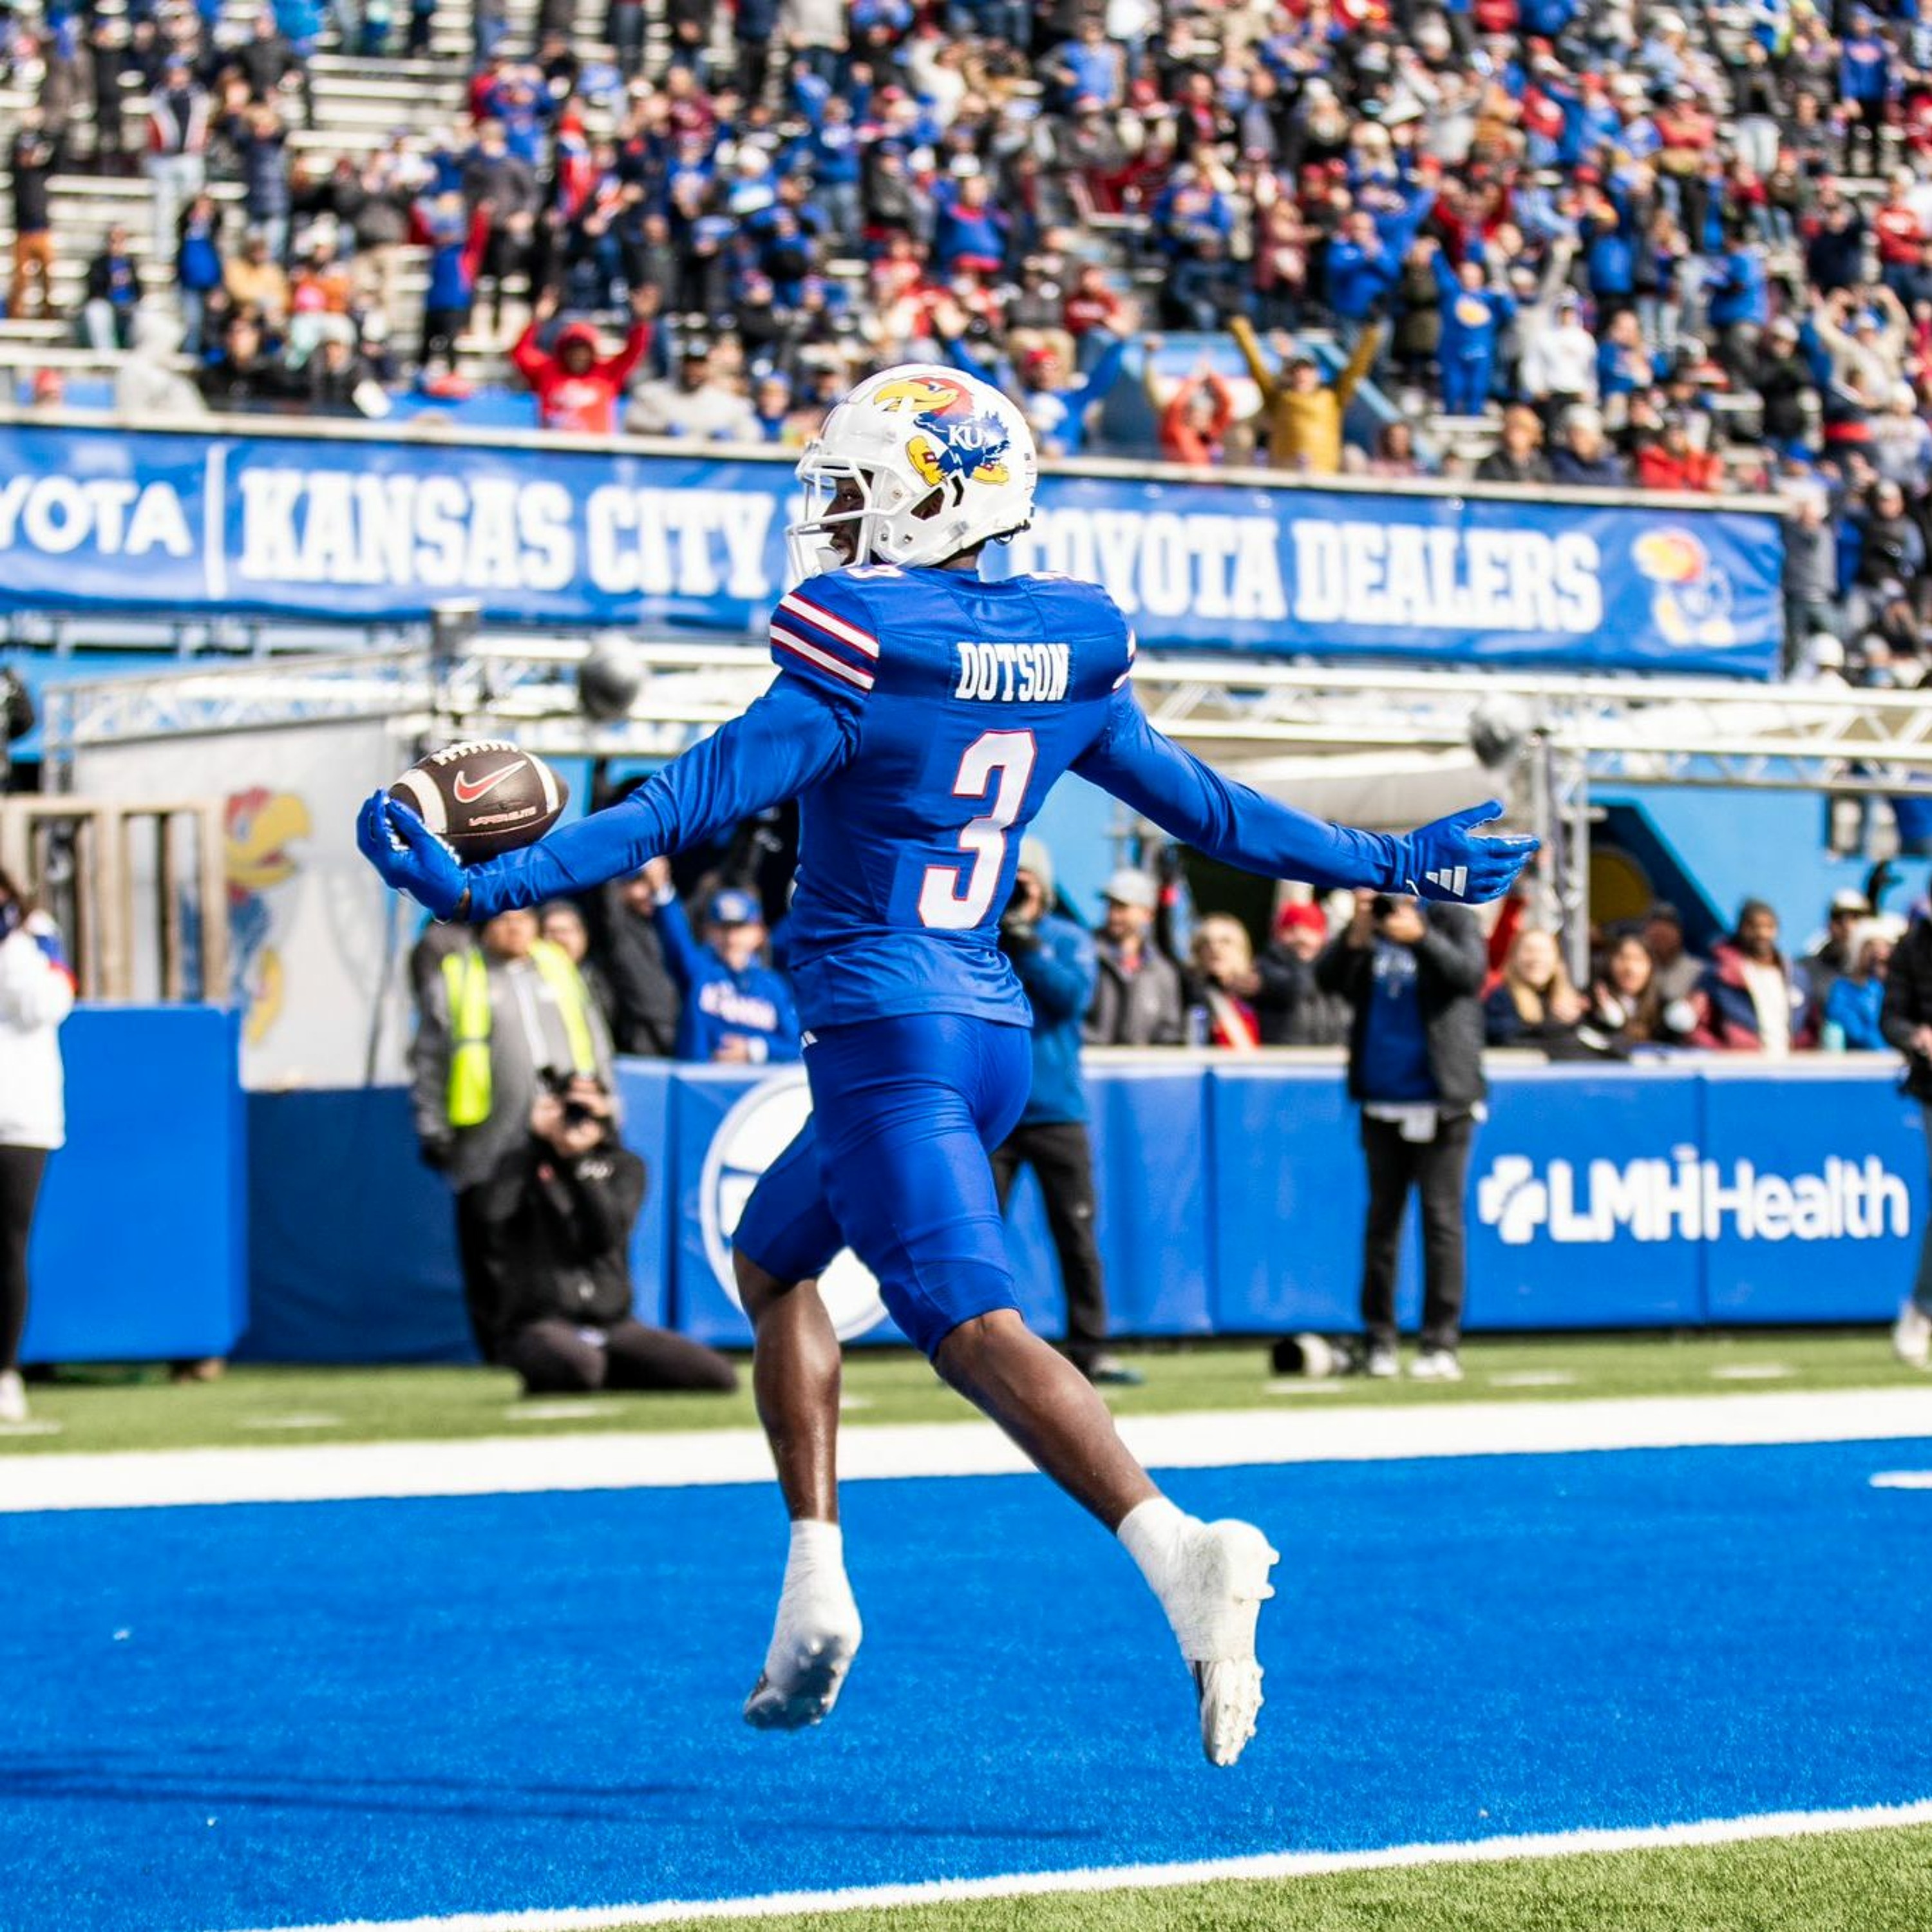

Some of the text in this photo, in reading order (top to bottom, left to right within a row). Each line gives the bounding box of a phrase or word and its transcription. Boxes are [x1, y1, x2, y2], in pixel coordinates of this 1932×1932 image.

[947, 424, 984, 451] KU
[238, 468, 576, 591] KANSAS
[585, 484, 777, 600] CITY
[1291, 517, 1602, 634] DEALERS
[954, 643, 1070, 702] DOTSON
[918, 730, 1037, 929] 3
